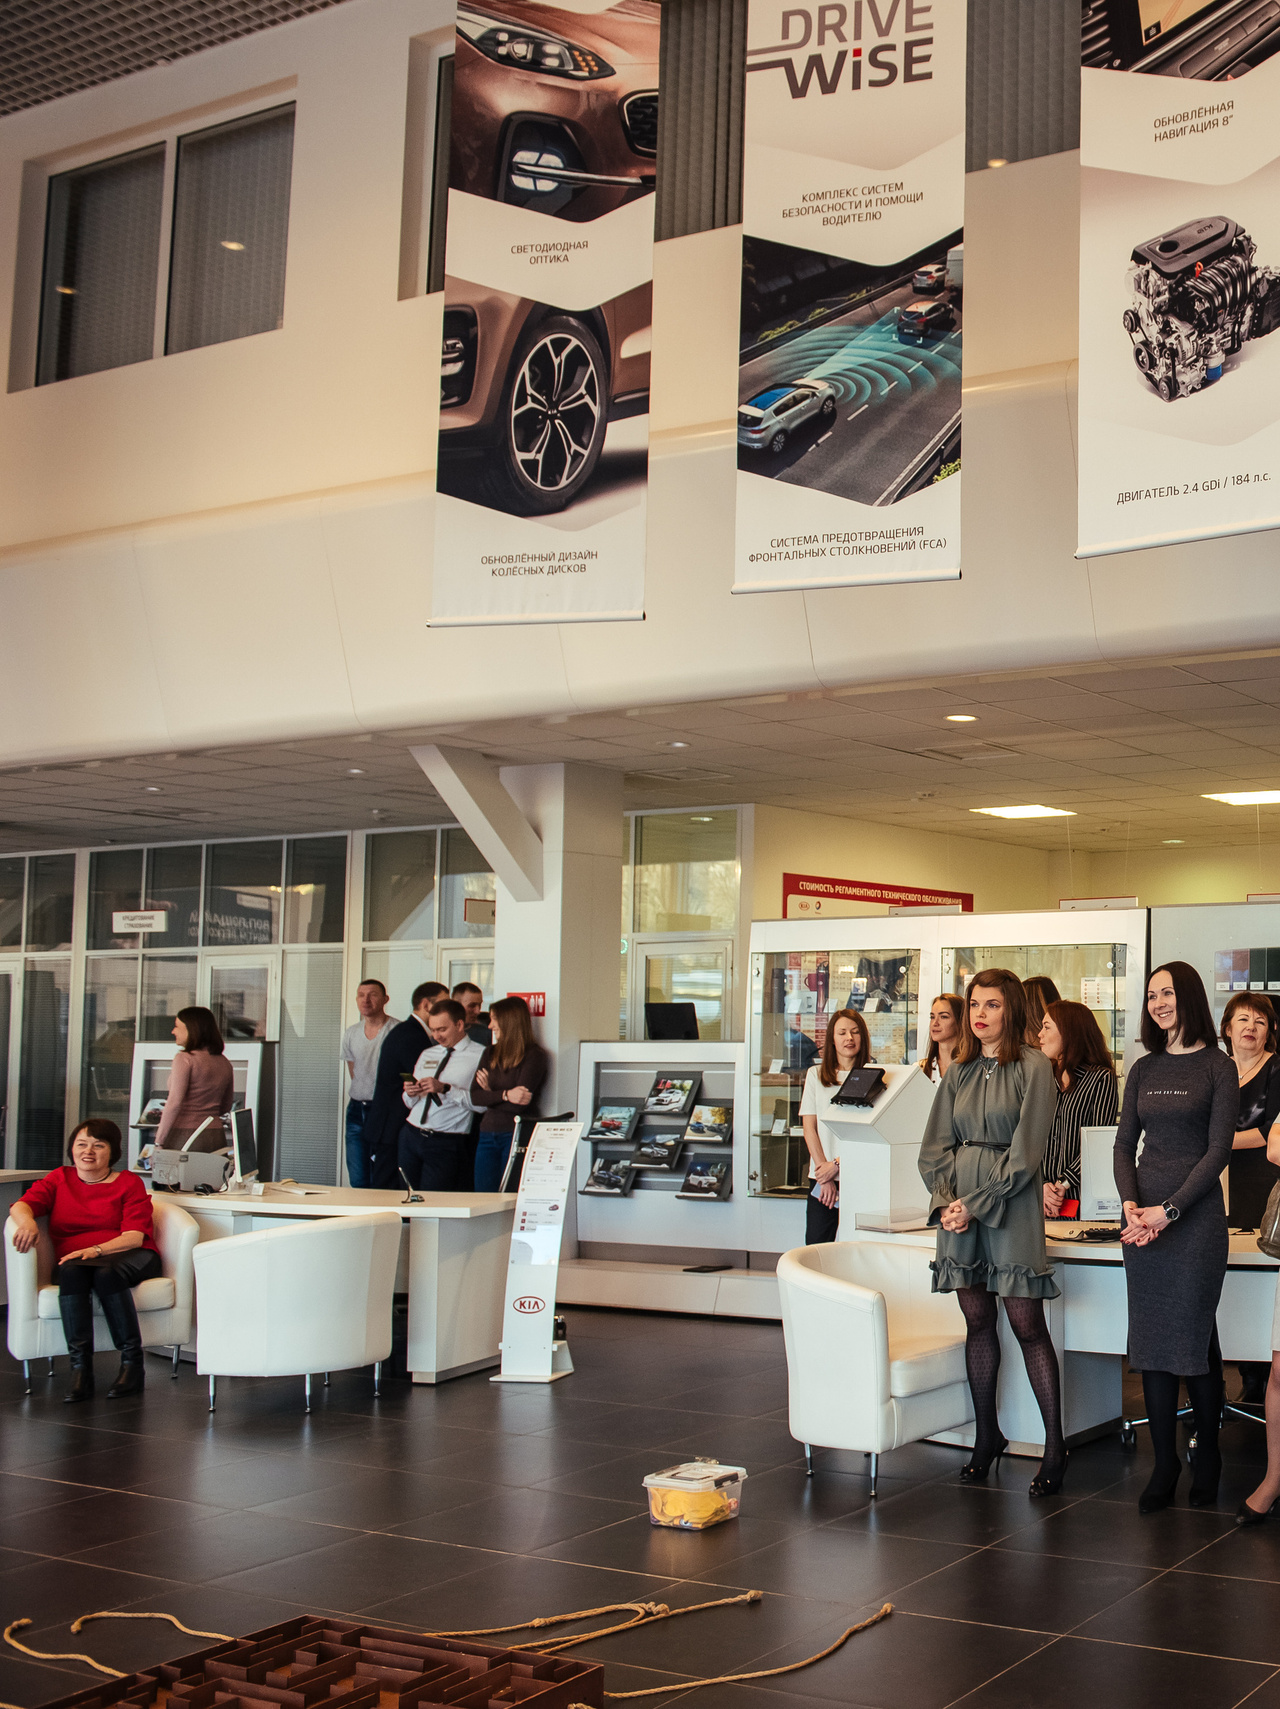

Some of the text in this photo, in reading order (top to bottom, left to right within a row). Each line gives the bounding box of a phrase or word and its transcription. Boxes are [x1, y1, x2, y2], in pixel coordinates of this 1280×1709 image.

[780, 0, 934, 50] DRIVE
[1153, 100, 1234, 128] ОБНОВЛЁННАЯ
[1154, 118, 1219, 142] НАВИГАЦИЯ
[801, 182, 904, 203] КОМПЛЕКС СИСТЕМ
[782, 192, 924, 218] БЕЗОПАСНОСТИ И ПОМОЩИ
[822, 211, 882, 226] ВОДИТЕЛЮ
[510, 240, 589, 254] СВЕТОДИОДНАЯ
[529, 254, 569, 265] ОПТИКА
[1116, 472, 1271, 505] ДВИГАТЕЛЬ 2.4 GDi / 184 л.с.
[770, 526, 924, 548] СИСТЕМА ПРЕДОТВРАЩЕНИЯ
[481, 549, 598, 565] ОБНОВЛЁННЫЙ ДИЗАЙН
[748, 537, 947, 562] ФРОНТАЛЬНЫХ СТОЛКНОВЕНИЙ (FCA)
[491, 563, 586, 577] КОЛЁСНЫХ ДИСКОВ
[798, 881, 834, 893] СТОИМОСТЬ
[835, 885, 882, 898] РЕГЛАМЕНТНОГО
[882, 890, 922, 902] ТЕХНИЧЕСКОГО
[519, 1300, 540, 1309] KIA
